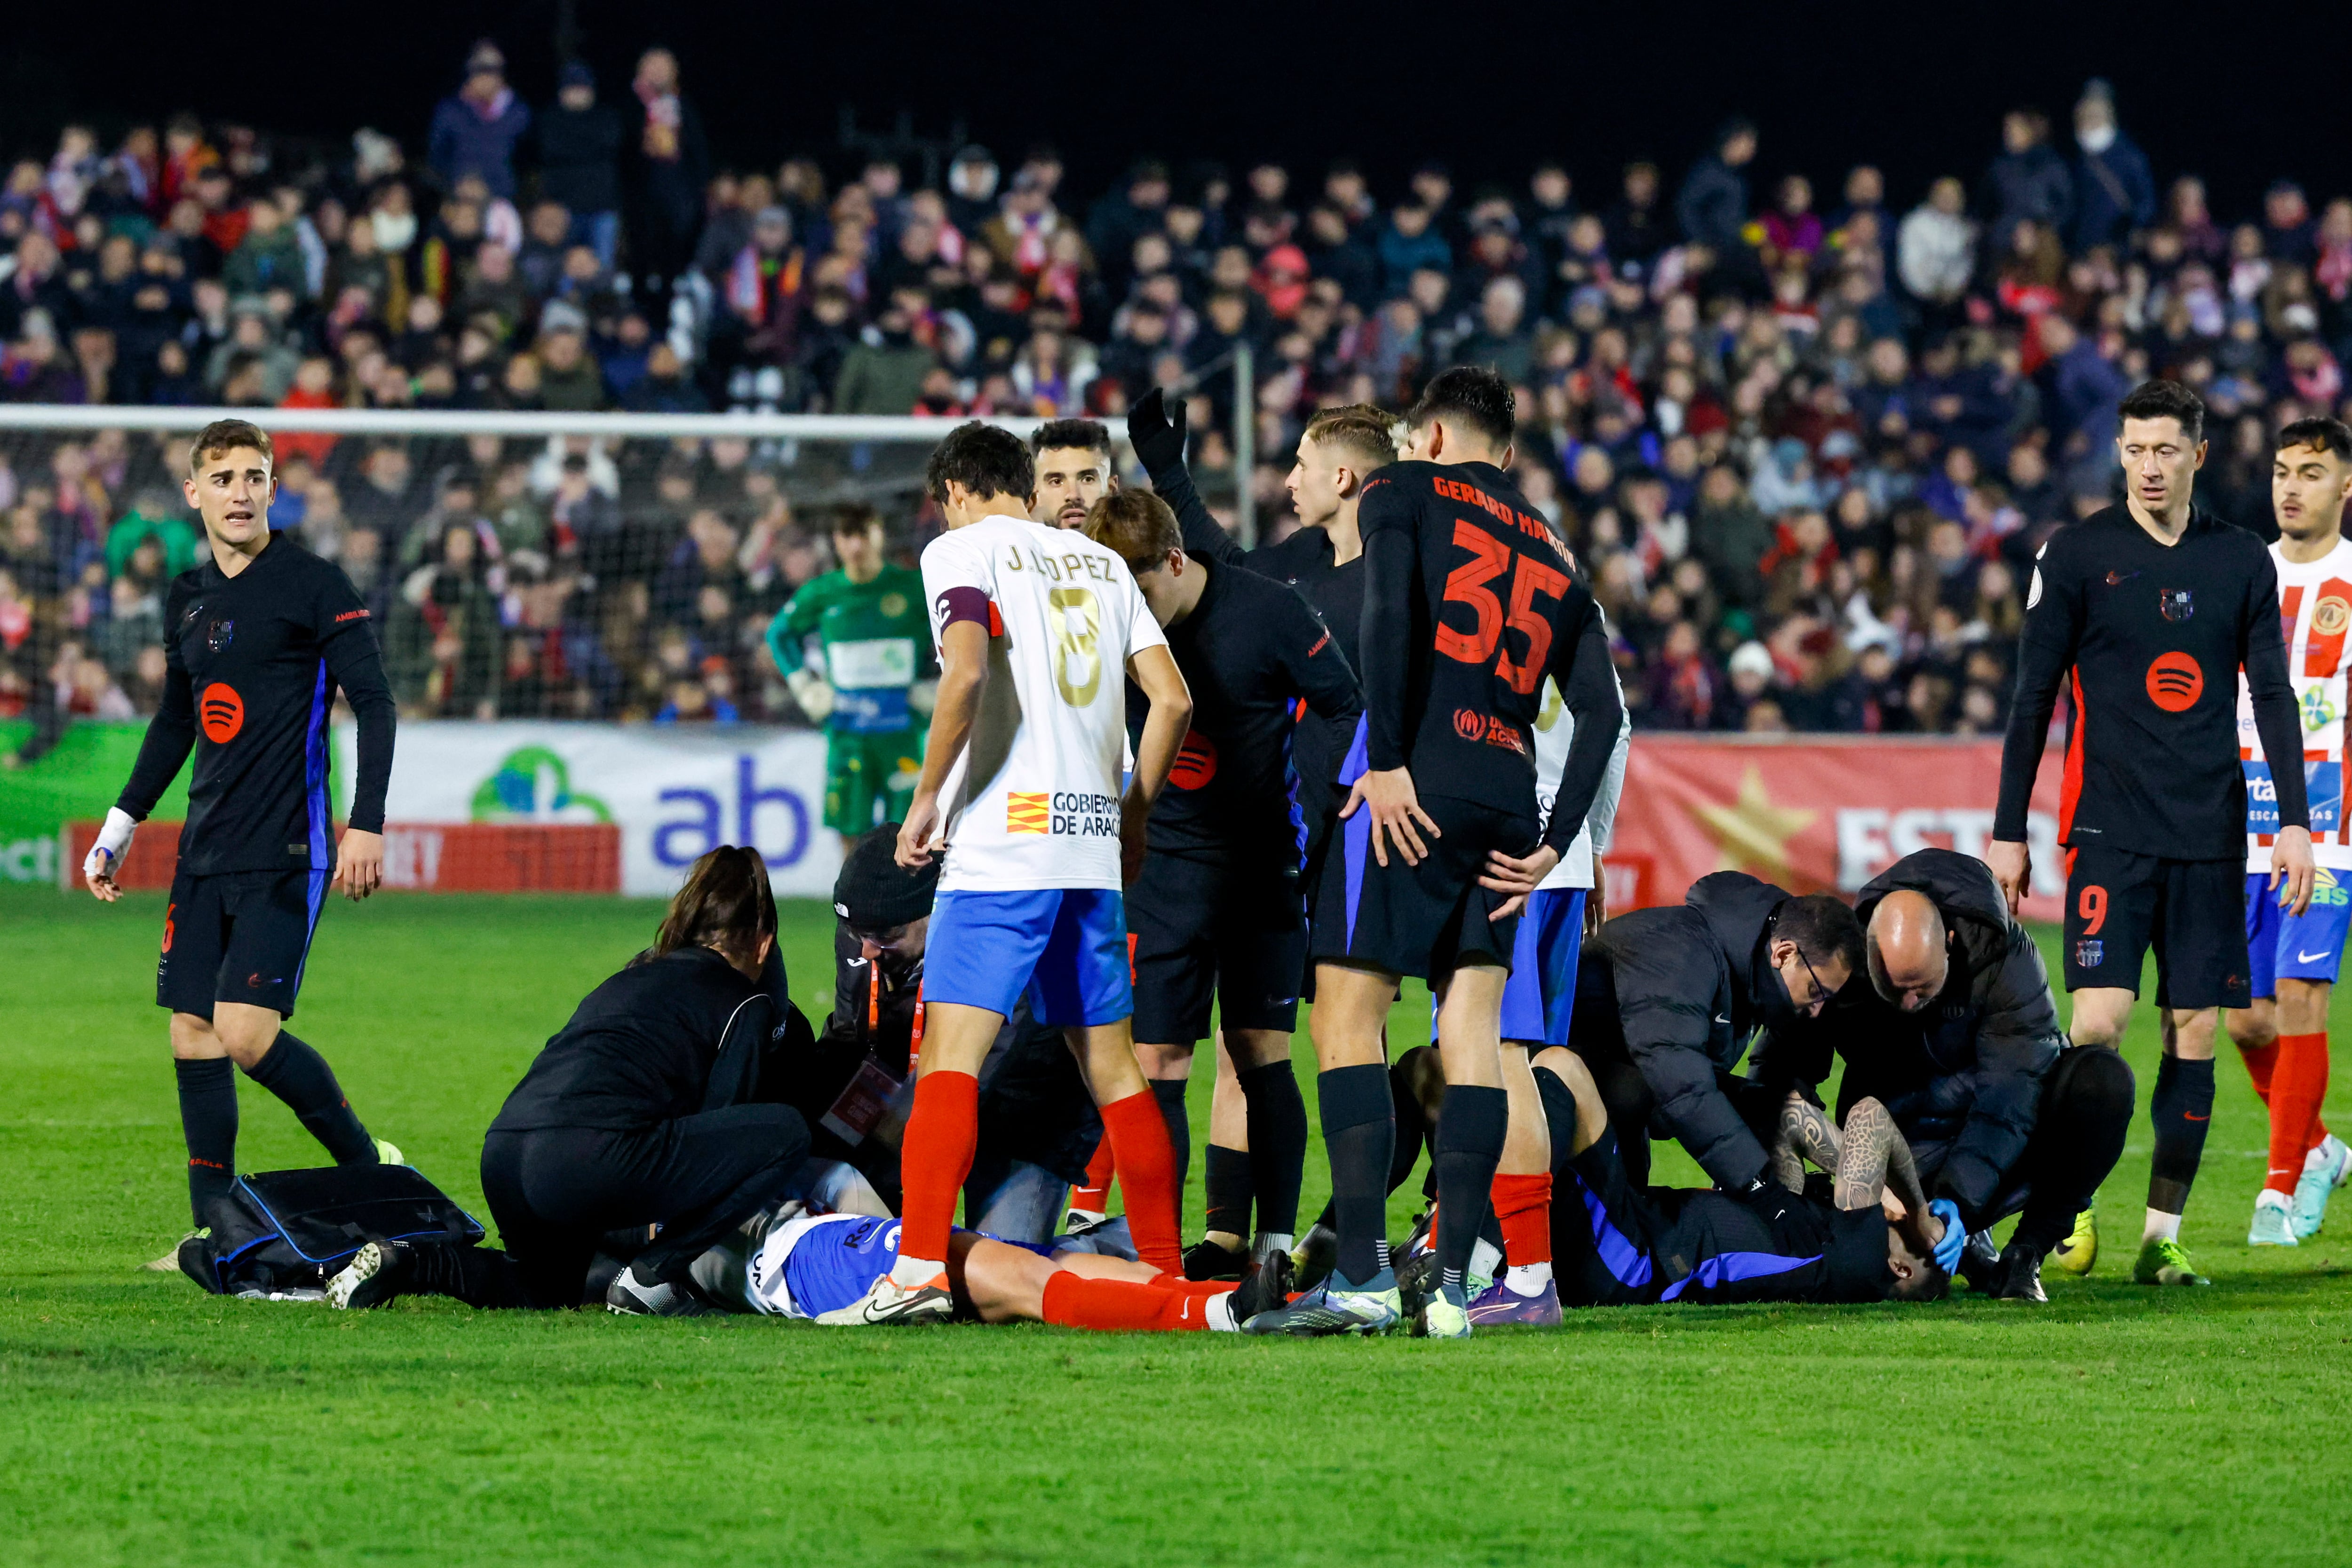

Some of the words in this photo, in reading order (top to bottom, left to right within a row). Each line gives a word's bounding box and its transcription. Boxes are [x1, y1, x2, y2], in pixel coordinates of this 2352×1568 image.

[1433, 476, 1515, 526] GERARD
[1435, 519, 1572, 695] 35
[1049, 587, 1102, 708] 8
[652, 754, 811, 870] ab
[1053, 792, 1120, 816] GOBIERNO
[1053, 815, 1076, 835] DE
[2079, 885, 2108, 935] 9
